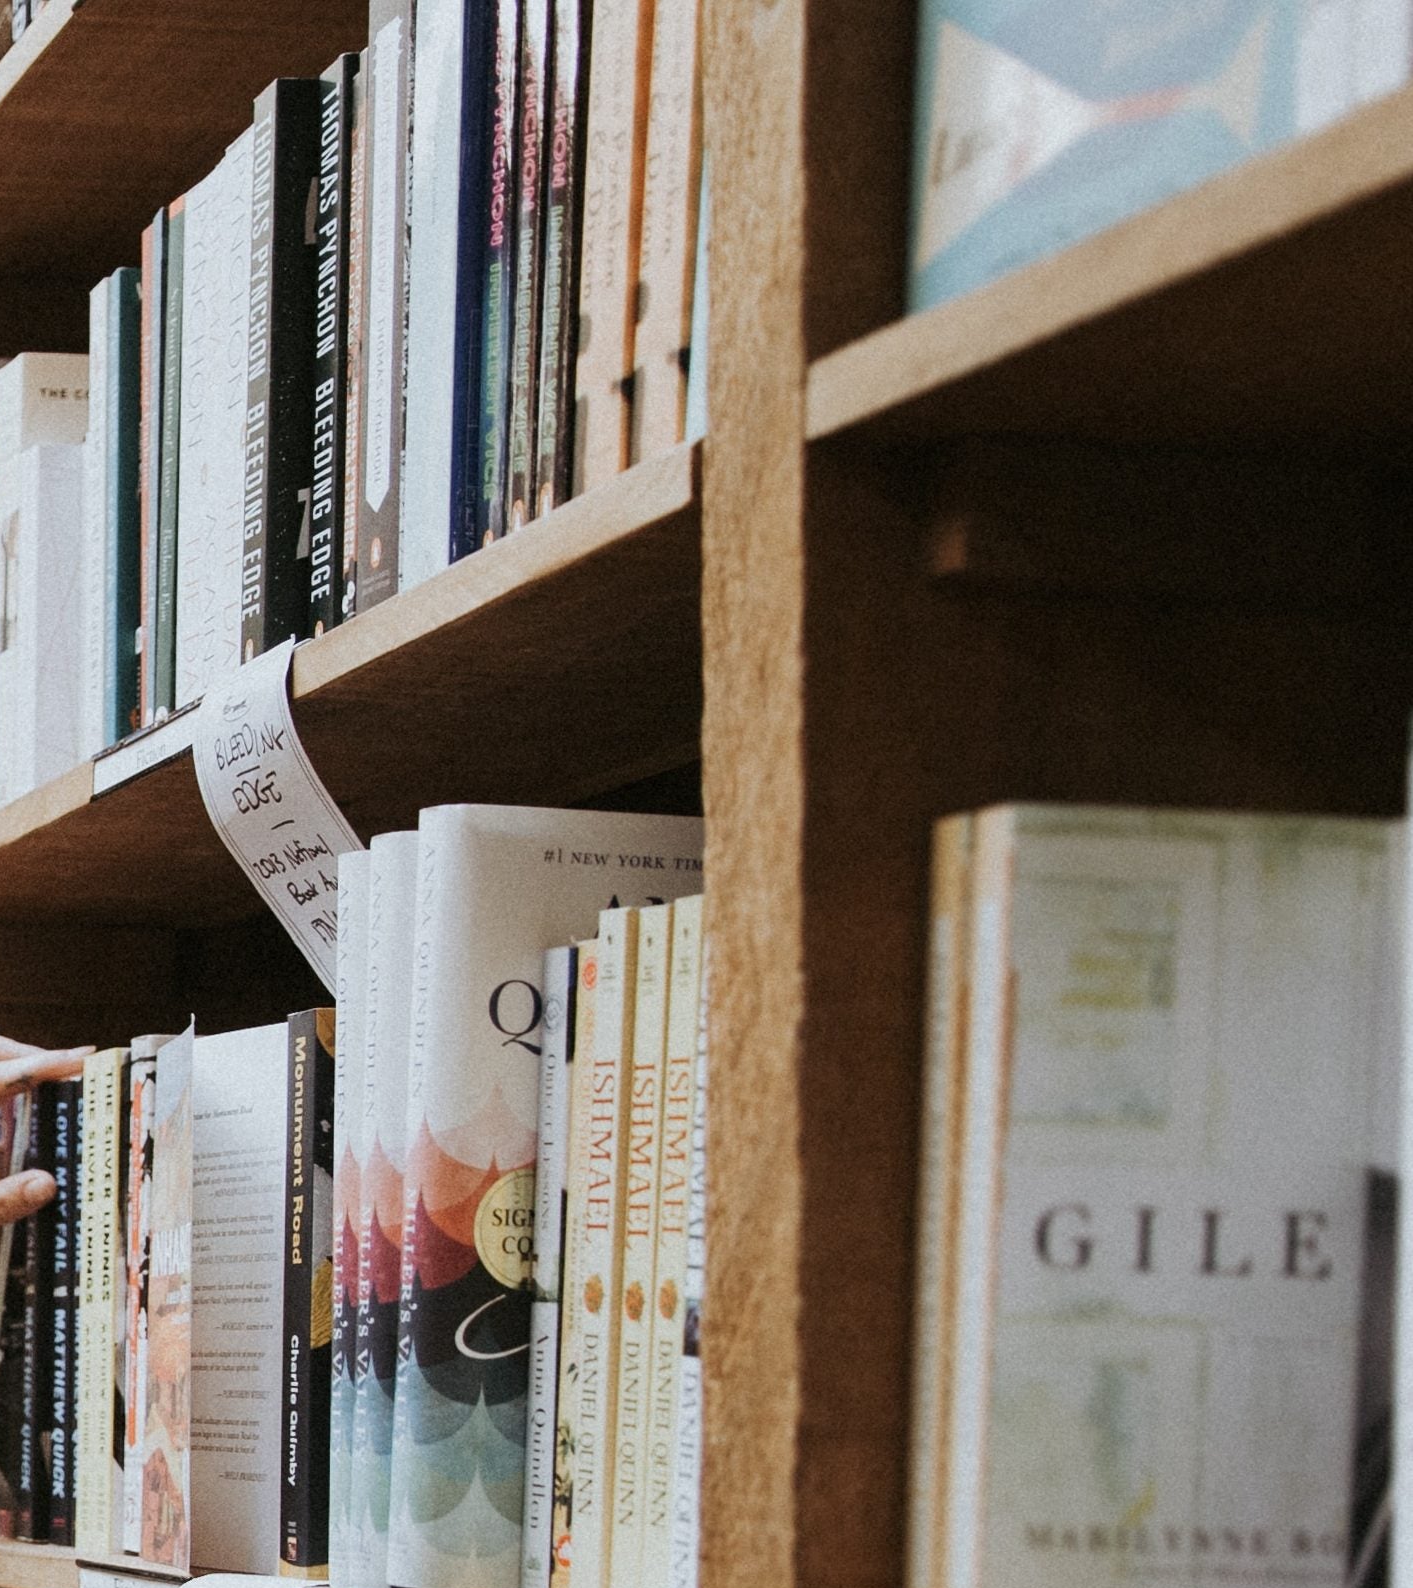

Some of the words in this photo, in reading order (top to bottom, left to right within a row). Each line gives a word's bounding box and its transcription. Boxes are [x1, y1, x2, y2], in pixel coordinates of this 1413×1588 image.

[252, 110, 273, 241] THOMAS
[318, 82, 341, 215] THOMAS
[490, 84, 507, 247] PYNCHON
[247, 243, 270, 383] PYNCHON
[315, 216, 338, 359] PYNCHON
[513, 227, 534, 385] INHERENT
[544, 203, 564, 369] INHERENT
[485, 263, 503, 421] INHERENT
[38, 386, 70, 400] THE
[513, 398, 530, 474] VICE
[539, 379, 558, 455] VICE
[244, 401, 266, 541] BLEEDING
[312, 375, 335, 521] BLEEDING
[483, 425, 500, 500] VICE
[241, 547, 262, 622] EDGE
[310, 526, 332, 604] EDGE
[231, 771, 283, 815] EDGE
[253, 857, 286, 879] 2013
[286, 879, 320, 906] Book
[543, 849, 564, 864] #1
[571, 851, 611, 867] NEW
[617, 853, 665, 870] YORK
[55, 1101, 69, 1159] LOVE
[291, 1035, 308, 1188] Monument
[584, 1059, 616, 1244] ISHMAEL
[627, 1062, 656, 1249] ISHMAEL
[661, 1056, 690, 1245] ISHMAEL
[103, 1125, 113, 1199] SILVER
[54, 1222, 68, 1274] FAIL
[84, 1214, 95, 1304] LININGS
[101, 1211, 112, 1303] LININGS
[290, 1195, 306, 1266] Road
[331, 1206, 349, 1341] MILLER'S
[358, 1205, 375, 1339] MILLER'S
[398, 1185, 418, 1325] MILLER'S
[1034, 1202, 1334, 1284] GILE
[52, 1308, 67, 1424] MATTHEW
[289, 1333, 301, 1397] Charlie
[394, 1334, 411, 1452] VALLEY
[534, 1335, 550, 1397] Anna
[580, 1332, 599, 1422] DANIEL
[621, 1340, 640, 1431] DANIEL
[655, 1339, 673, 1430] DANIEL
[50, 1427, 66, 1499] QUICK
[286, 1401, 299, 1487] Quimby
[529, 1407, 548, 1530] Quindlen
[576, 1431, 596, 1516] QUINN
[618, 1440, 636, 1525] QUINN
[650, 1441, 670, 1527] QUINN
